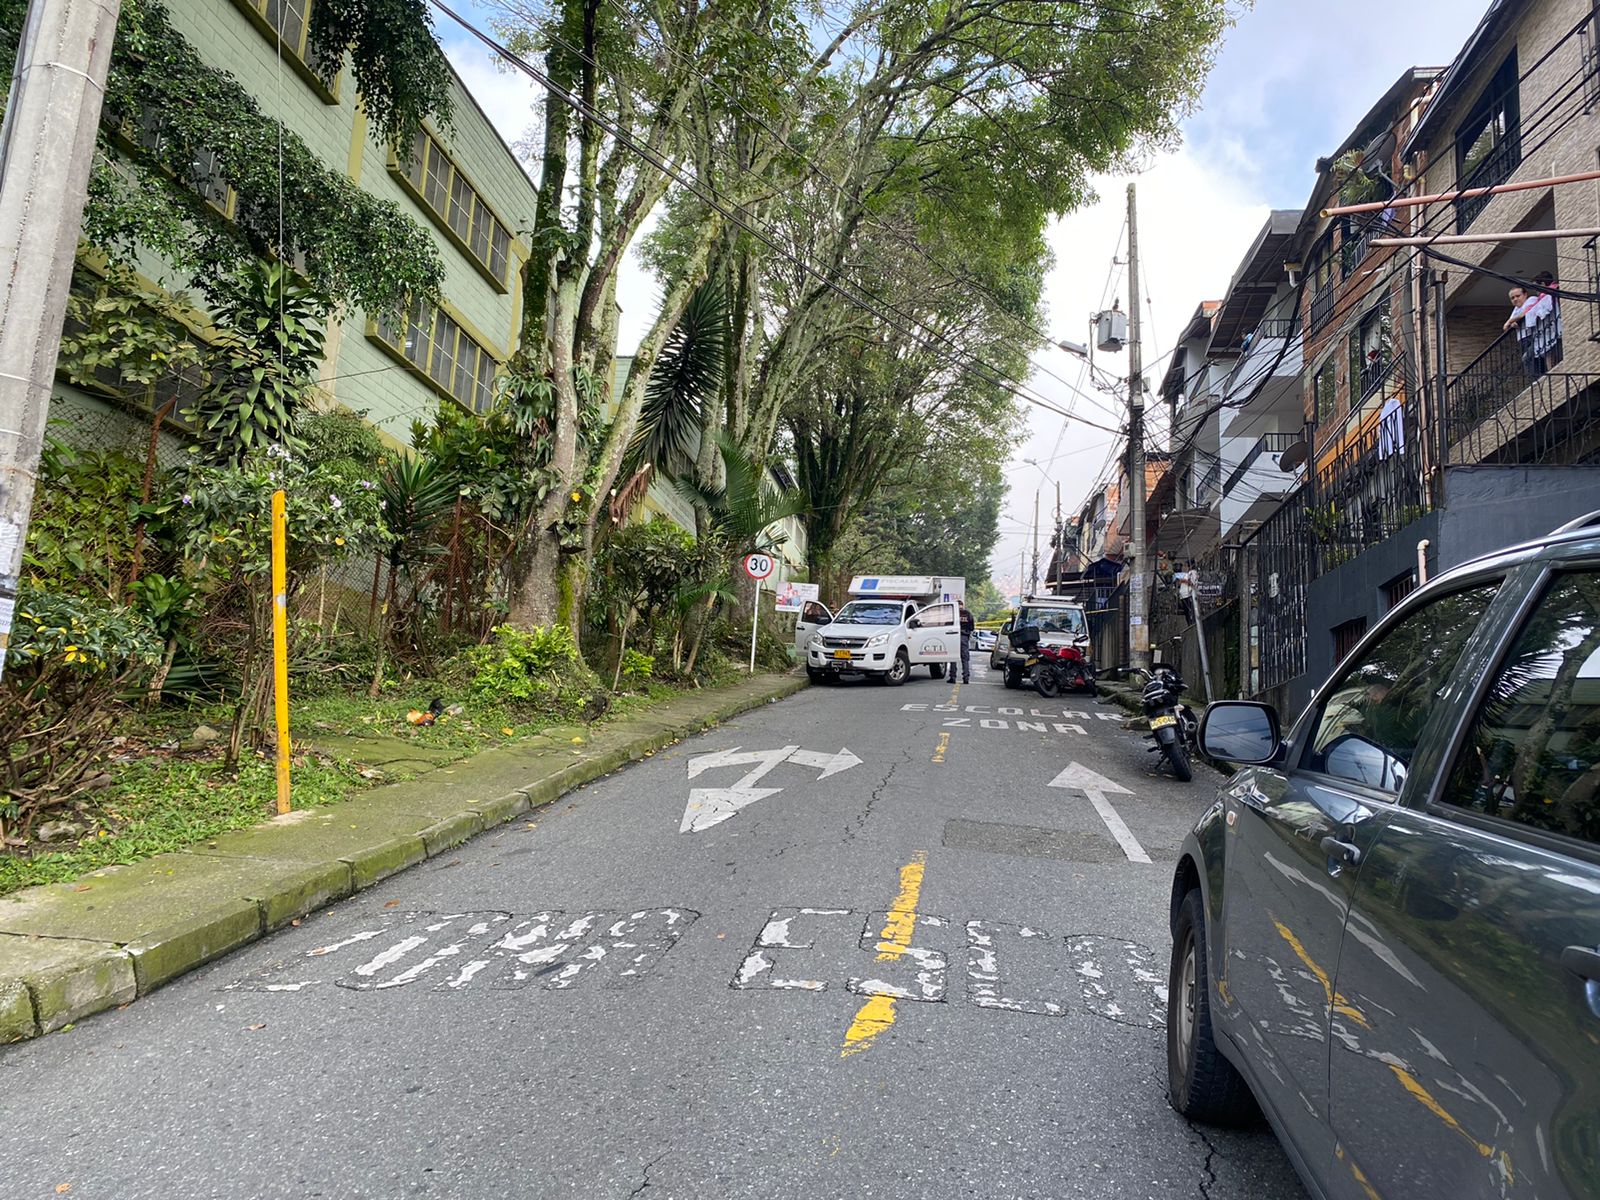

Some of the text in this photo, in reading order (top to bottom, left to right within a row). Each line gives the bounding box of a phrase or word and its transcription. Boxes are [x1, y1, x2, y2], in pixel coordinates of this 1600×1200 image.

[750, 558, 768, 572] 30
[900, 703, 1124, 722] ESCOLAR
[942, 717, 1088, 735] ZONA
